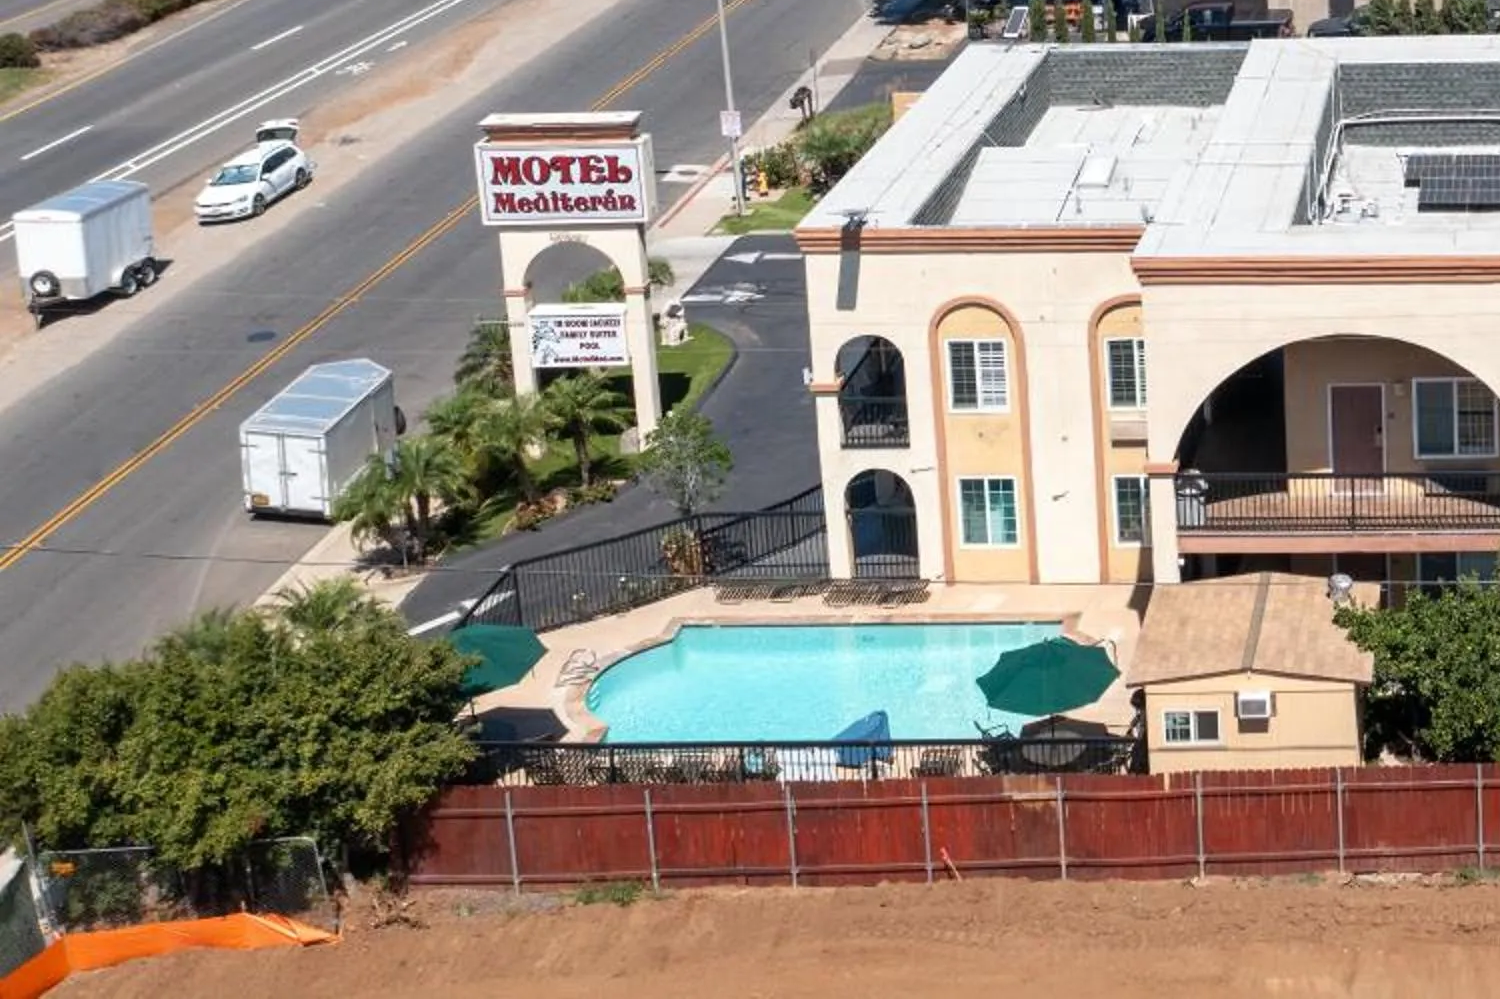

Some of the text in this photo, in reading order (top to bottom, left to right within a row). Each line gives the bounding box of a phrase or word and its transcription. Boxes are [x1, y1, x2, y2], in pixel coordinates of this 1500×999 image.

[490, 155, 633, 185] MOTEL
[561, 330, 588, 339] FAMILY
[580, 342, 601, 350] POOL
